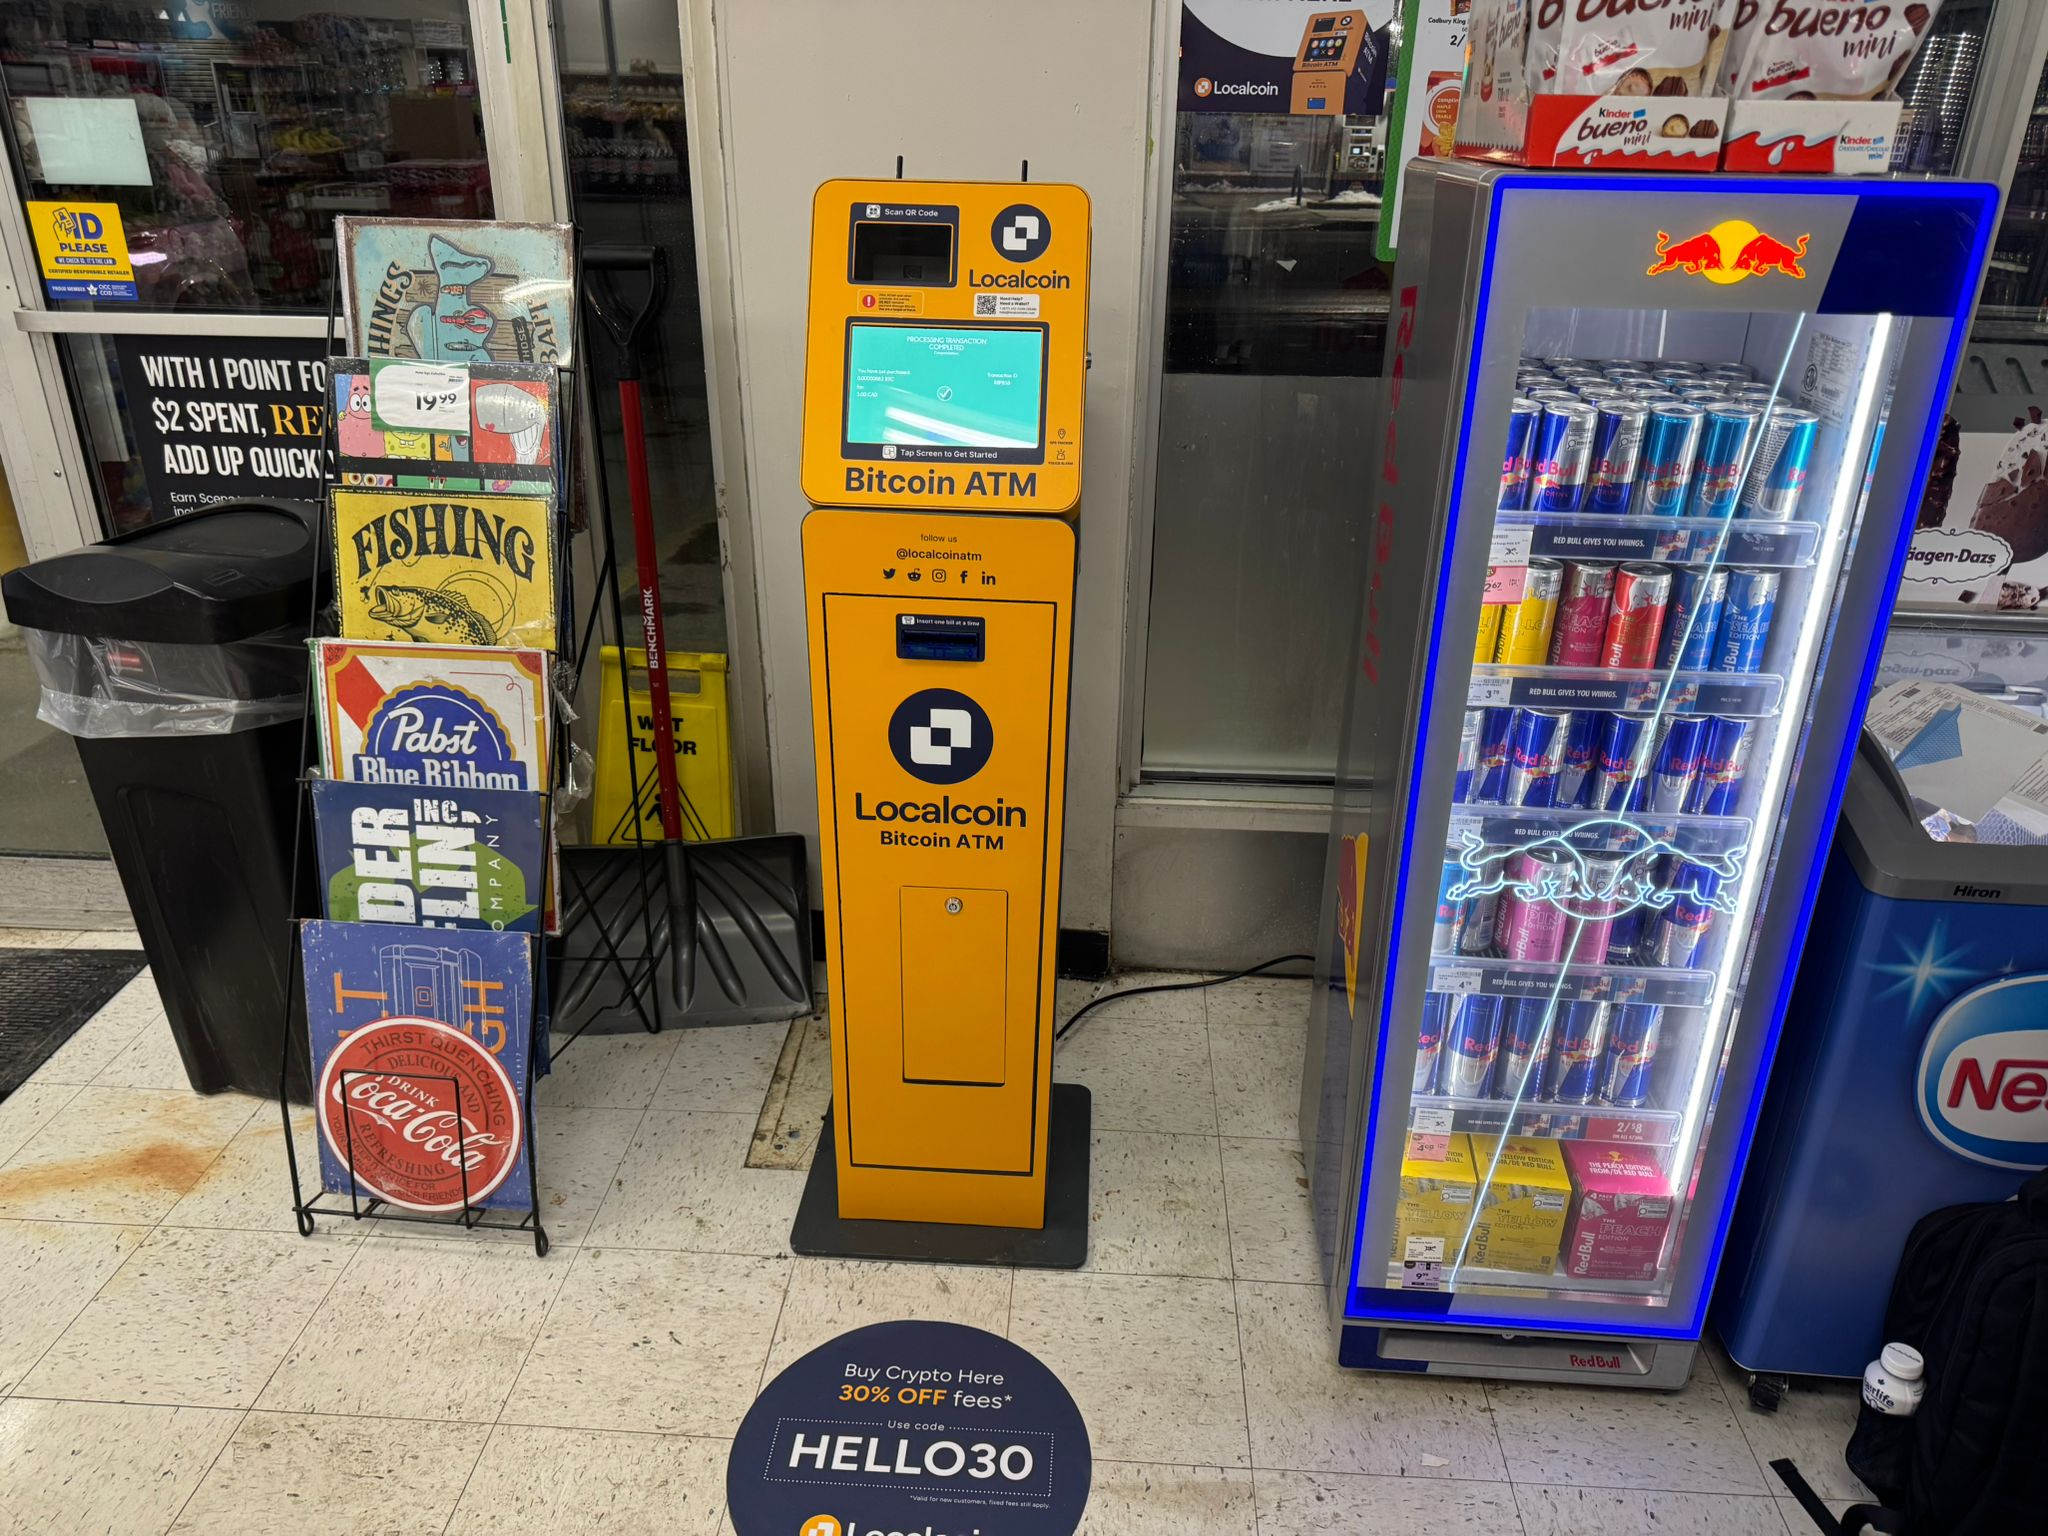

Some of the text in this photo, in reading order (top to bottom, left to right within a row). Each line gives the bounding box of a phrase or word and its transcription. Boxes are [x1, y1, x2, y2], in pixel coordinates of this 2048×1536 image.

[1428, 17, 1466, 26] Cadbury King
[1765, 0, 1891, 38] bueno
[1843, 31, 1897, 59] mini
[1213, 81, 1279, 96] Localcoin
[1599, 107, 1631, 118] Kinder
[1578, 117, 1648, 141] bueno
[1624, 131, 1651, 146] mini
[1840, 134, 1873, 145] Kinder
[884, 208, 939, 217] Scan QR Code
[69, 212, 104, 240] ID
[59, 243, 109, 253] PLEASE
[969, 269, 1070, 289] Localcoin
[929, 343, 965, 351] COMPLETED
[945, 337, 987, 345] TRANSACTION
[140, 356, 206, 389] WITH
[222, 358, 293, 392] POINT
[152, 396, 267, 438] $2 SPENT,
[163, 443, 210, 475] ADD
[213, 445, 245, 476] UP
[900, 449, 998, 459] Tap Screen to Get Started
[845, 467, 1037, 497] Bitcoin ATM
[170, 492, 197, 503] Earn
[351, 503, 536, 583] FISHING
[920, 534, 945, 543] follow
[1553, 536, 1566, 544] RED
[1567, 537, 1582, 545] BULL
[1583, 537, 1602, 546] GIVES
[1603, 538, 1615, 546] YOU
[896, 548, 982, 562] @localcoinatm
[642, 588, 659, 670] BENCHMARK
[1609, 643, 1623, 665] Bull
[1725, 641, 1741, 665] Bull
[1558, 689, 1575, 697] GIVES
[388, 706, 480, 755] Pabst
[1515, 747, 1539, 766] Red
[1600, 752, 1629, 770] Red
[359, 756, 519, 790] Blue Ribbon
[855, 792, 1027, 828] Localcoin
[880, 830, 1003, 850] Bitcoin ATM
[1515, 828, 1526, 836] RED
[1526, 829, 1541, 837] BULL
[485, 814, 505, 932] OMPANY
[1953, 885, 2001, 899] Hiron
[1675, 906, 1705, 922] Red
[1516, 926, 1529, 950] Bull
[360, 1032, 506, 1127] THIRST QUENCHING
[388, 1075, 440, 1108] DRINK
[459, 1083, 481, 1114] AND
[332, 1070, 510, 1172] Coca-Cola
[360, 1122, 446, 1177] REFRESHING
[1589, 1167, 1622, 1176] FROM/DE
[1604, 1162, 1625, 1170] PEACH
[1626, 1163, 1653, 1172] EDITION
[1600, 1224, 1662, 1236] PEACH
[1574, 1231, 1596, 1275] Red Bull
[1570, 1354, 1621, 1369] Red Bull
[844, 1363, 1005, 1387] Buy Crypto Here
[838, 1384, 890, 1404] 30%
[897, 1386, 948, 1406] OFF
[887, 1419, 945, 1432] Use code
[788, 1432, 1034, 1481] HELLO30
